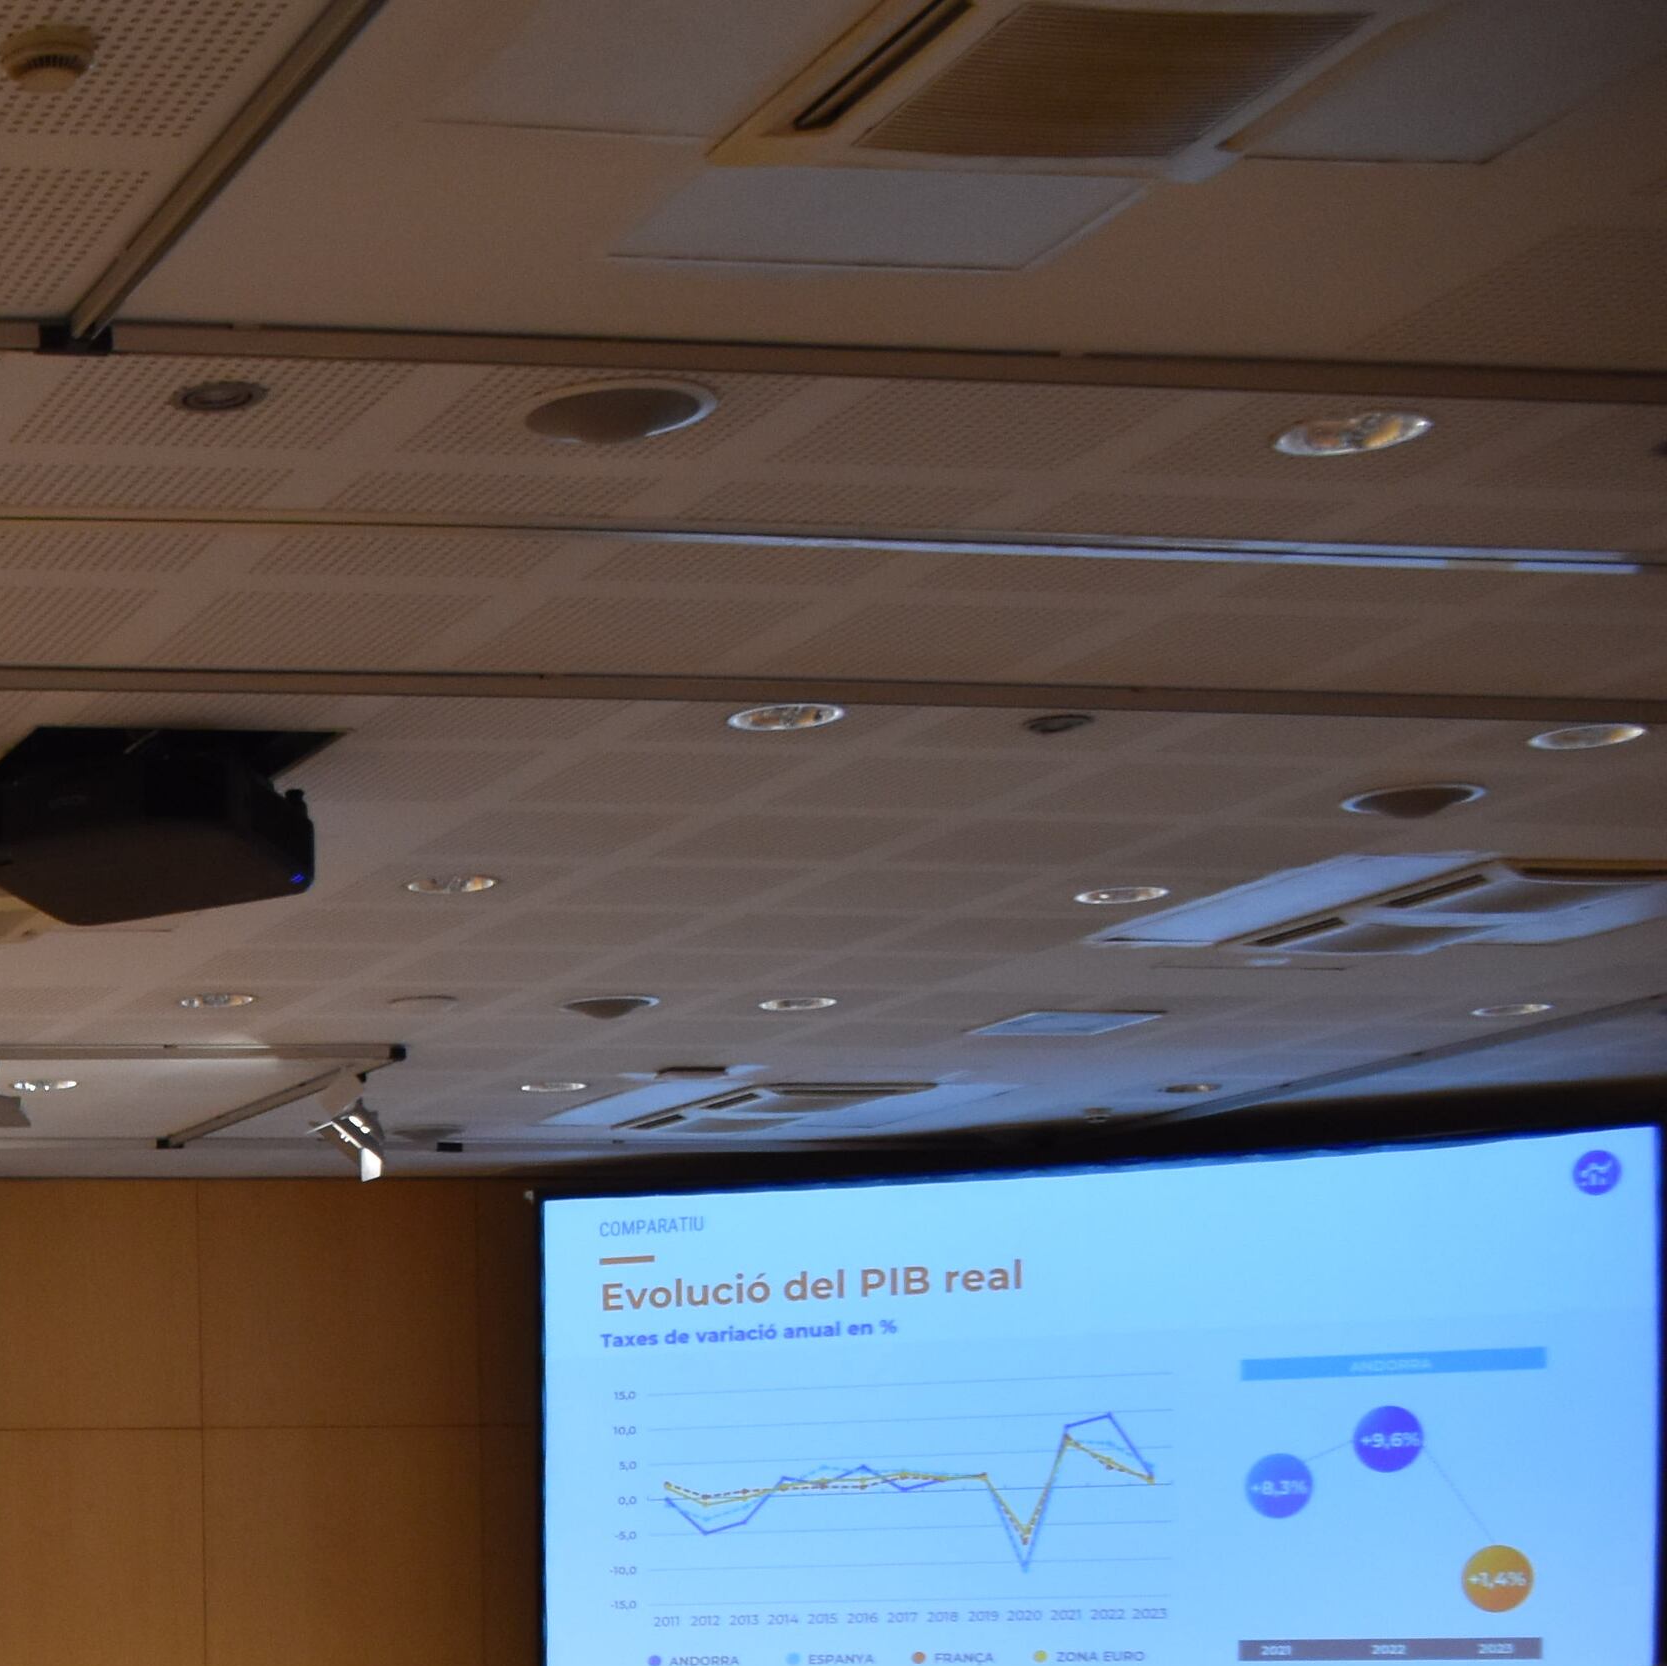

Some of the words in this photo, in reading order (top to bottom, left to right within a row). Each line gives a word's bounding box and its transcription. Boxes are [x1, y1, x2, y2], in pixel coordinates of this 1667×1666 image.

[599, 1215, 706, 1237] COMPARATIU
[601, 1271, 770, 1312] Evolució
[784, 1269, 845, 1302] del
[860, 1266, 930, 1297] PIB
[944, 1258, 1023, 1294] real
[601, 1331, 658, 1348] Taxes
[665, 1328, 690, 1345] de
[696, 1323, 777, 1344] variació
[783, 1320, 841, 1340] anual
[847, 1321, 873, 1337] en
[879, 1319, 898, 1335] %
[613, 1390, 637, 1402] 15,0
[612, 1425, 637, 1437] 10,0
[618, 1460, 637, 1471] 5,0
[618, 1495, 637, 1506] 0,0
[615, 1530, 637, 1541] -5,0
[609, 1565, 637, 1577] -10,0
[654, 1616, 680, 1627] 2011
[691, 1615, 720, 1627] 2012
[730, 1615, 759, 1626] 2013
[768, 1614, 799, 1625] 2014
[808, 1613, 837, 1624] 2015
[848, 1613, 878, 1624] 2016
[888, 1612, 917, 1623] 2017
[927, 1611, 959, 1622] 2018
[968, 1611, 999, 1622] 2019
[1007, 1610, 1042, 1621] 2020
[1050, 1609, 1081, 1620] 2021
[1090, 1609, 1125, 1620] 2022
[1132, 1608, 1167, 1619] 2023
[670, 1655, 739, 1666] ANDORRA
[808, 1653, 875, 1665] ESPANYA
[934, 1652, 994, 1666] FRANÇA
[1056, 1651, 1098, 1662] ZONA
[1103, 1651, 1145, 1662] EURO
